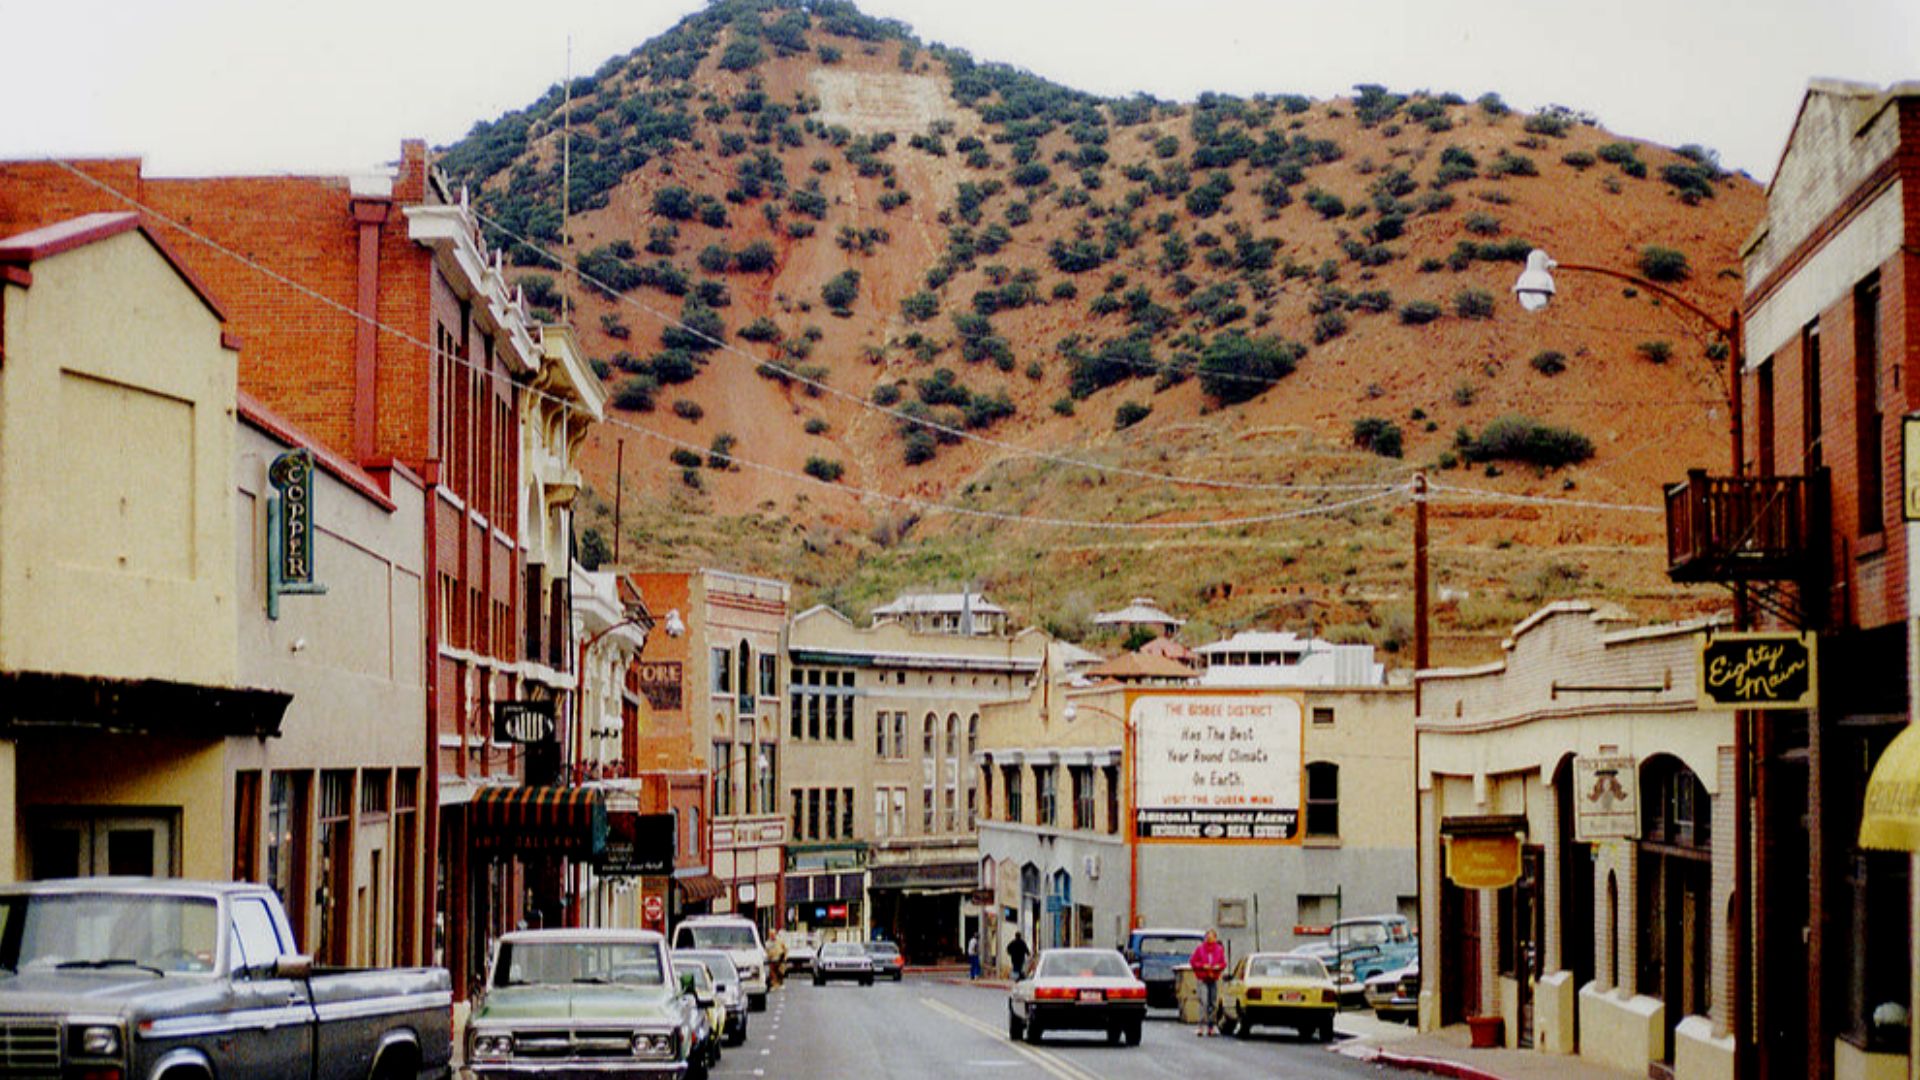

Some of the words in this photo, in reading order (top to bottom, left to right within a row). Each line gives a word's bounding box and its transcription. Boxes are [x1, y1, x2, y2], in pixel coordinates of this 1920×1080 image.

[288, 467, 306, 576] COPPER
[1709, 645, 1784, 687] Eighty
[1735, 660, 1806, 699] Main
[1166, 704, 1183, 716] THE
[1189, 704, 1222, 716] BISBEE
[1228, 704, 1272, 717] DISTRICT
[1182, 727, 1201, 741] Has
[1208, 726, 1225, 741] The
[1230, 726, 1254, 741] Best
[1168, 748, 1188, 762] Year
[1194, 748, 1223, 762] Round
[1229, 748, 1268, 762] Climate
[1193, 772, 1205, 785] On
[1163, 796, 1186, 804] VISIT
[1193, 796, 1208, 804] THE
[1214, 796, 1245, 805] QUEEN
[1250, 796, 1274, 804] MINE
[1191, 810, 1254, 823] INSURANCE
[1255, 810, 1296, 823] AGENCY
